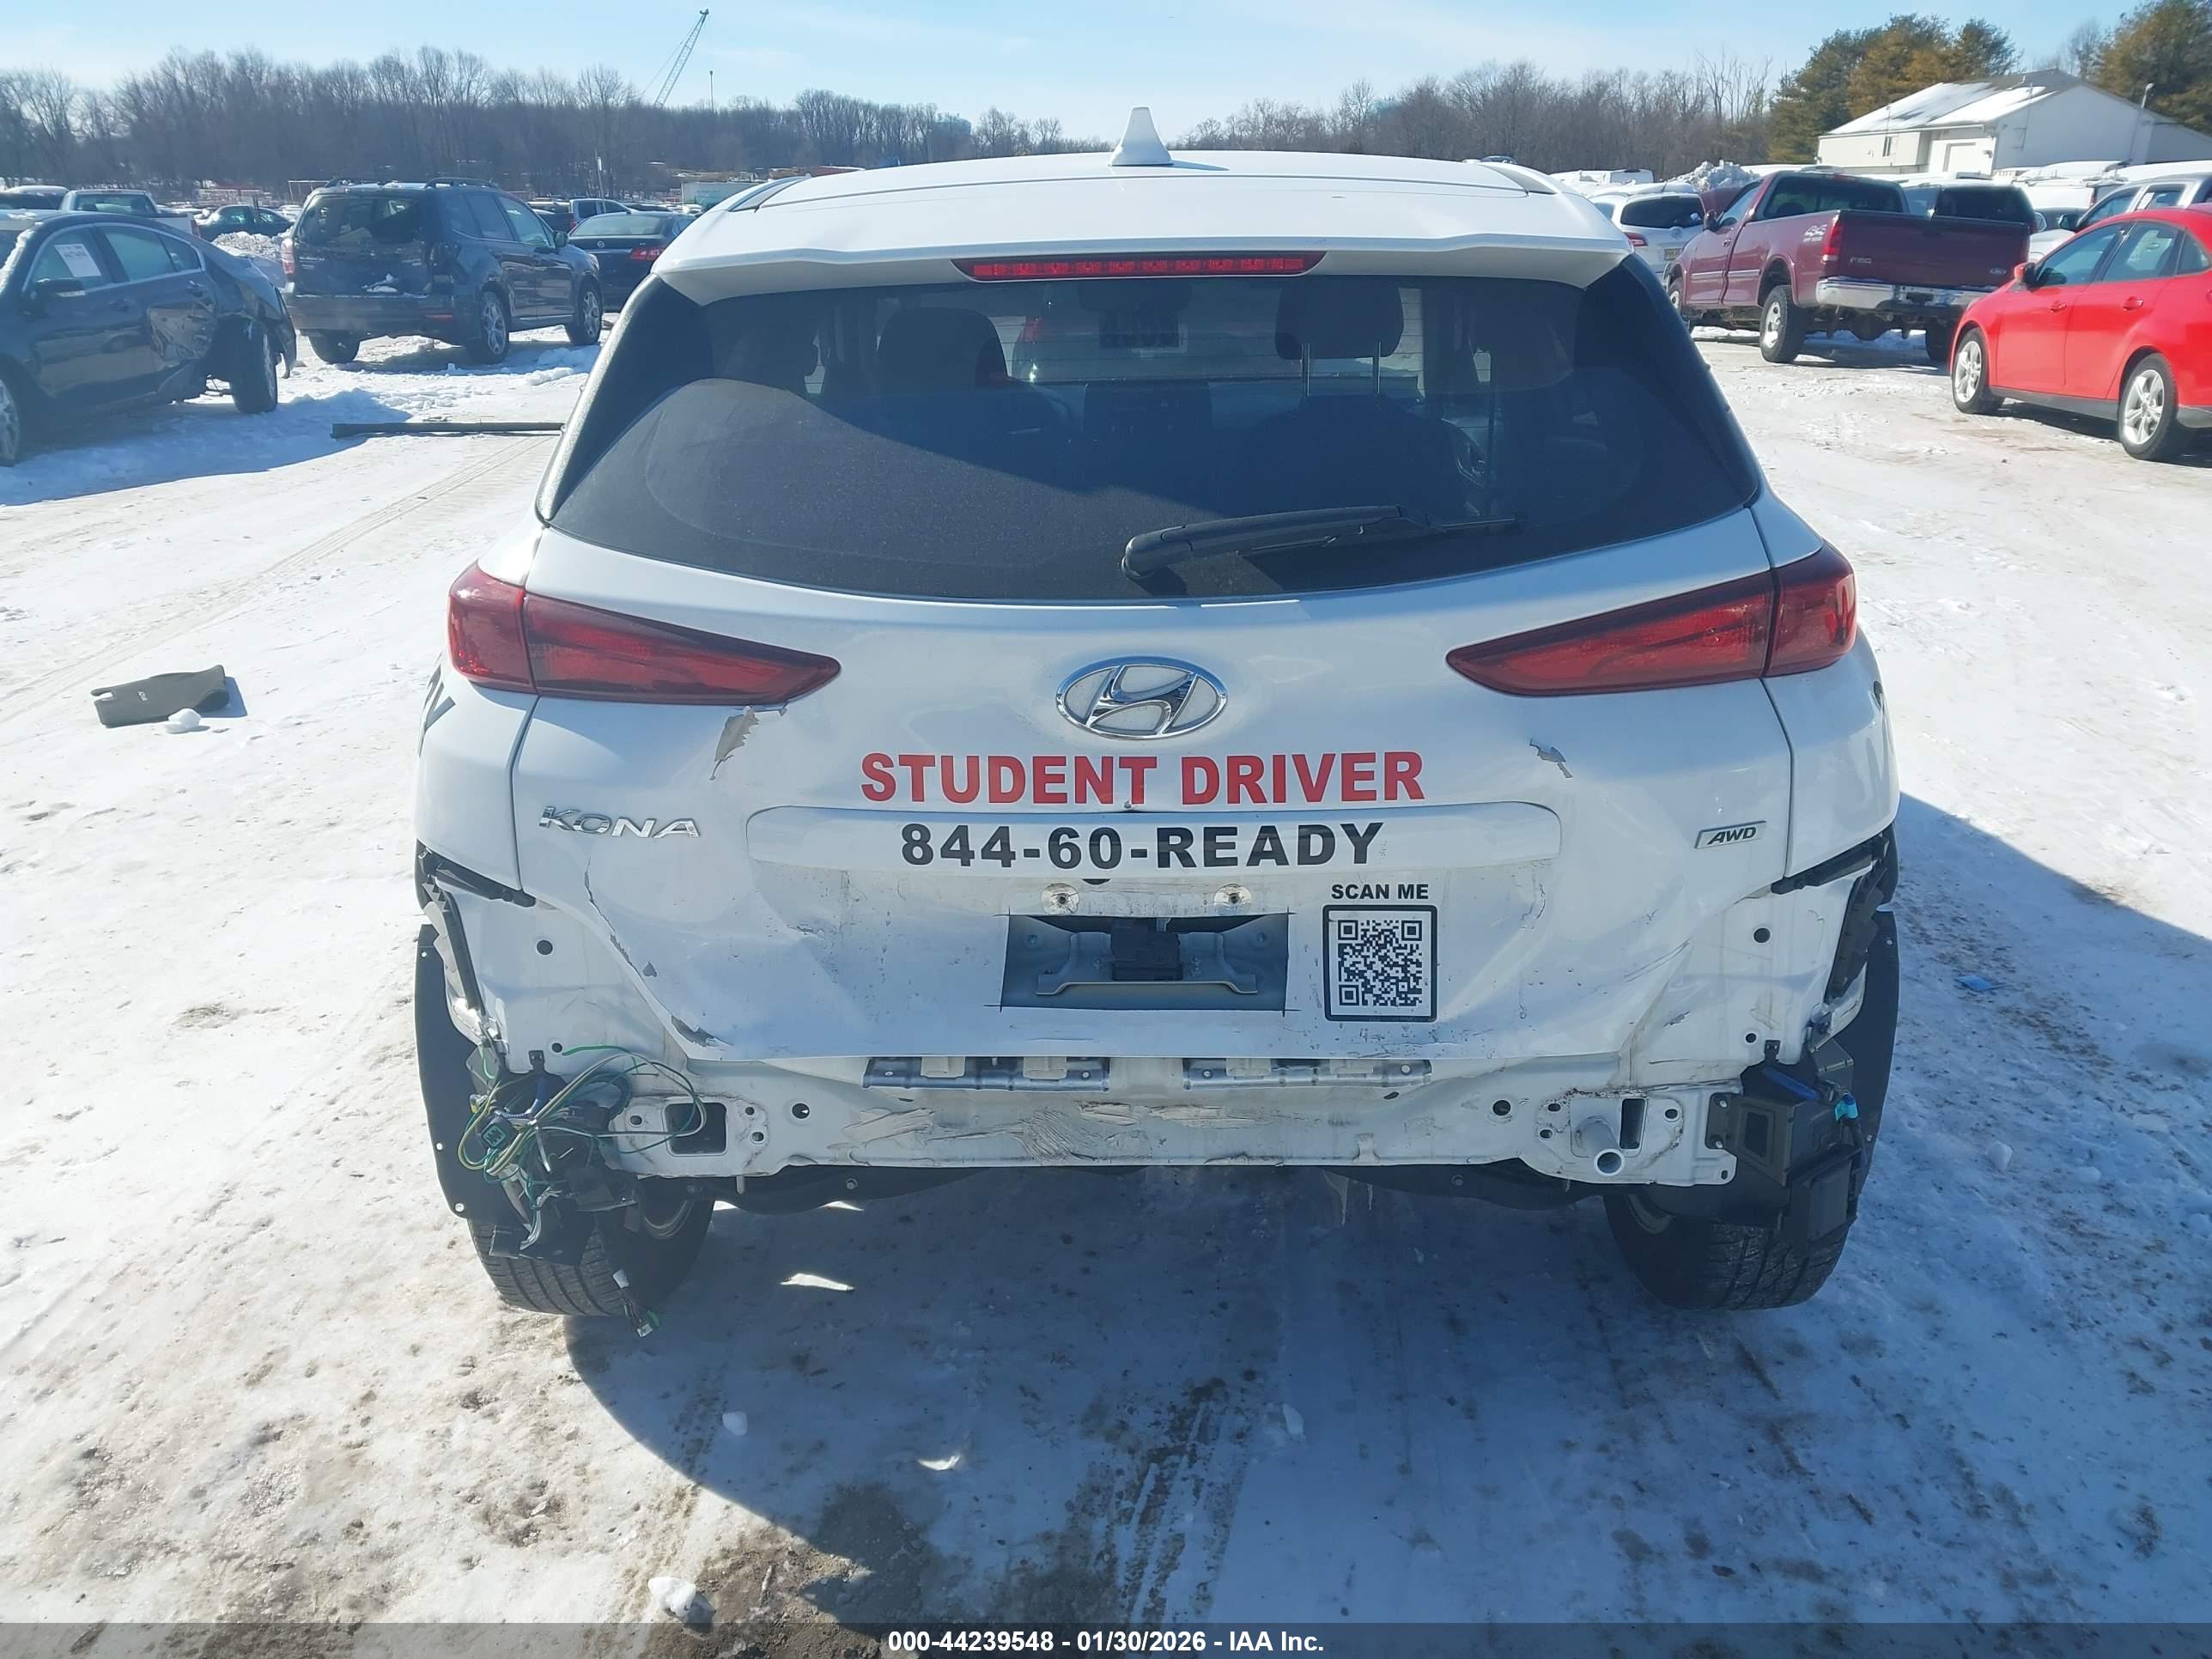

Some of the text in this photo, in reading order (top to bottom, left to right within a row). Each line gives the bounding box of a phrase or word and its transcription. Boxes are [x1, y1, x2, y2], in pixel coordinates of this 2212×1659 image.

[861, 750, 1425, 805] STUDENT DRIVER
[539, 806, 700, 839] KONA
[1706, 826, 1757, 846] AWD
[902, 822, 1384, 870] 844-60-READY
[1331, 884, 1429, 900] SCAN ME
